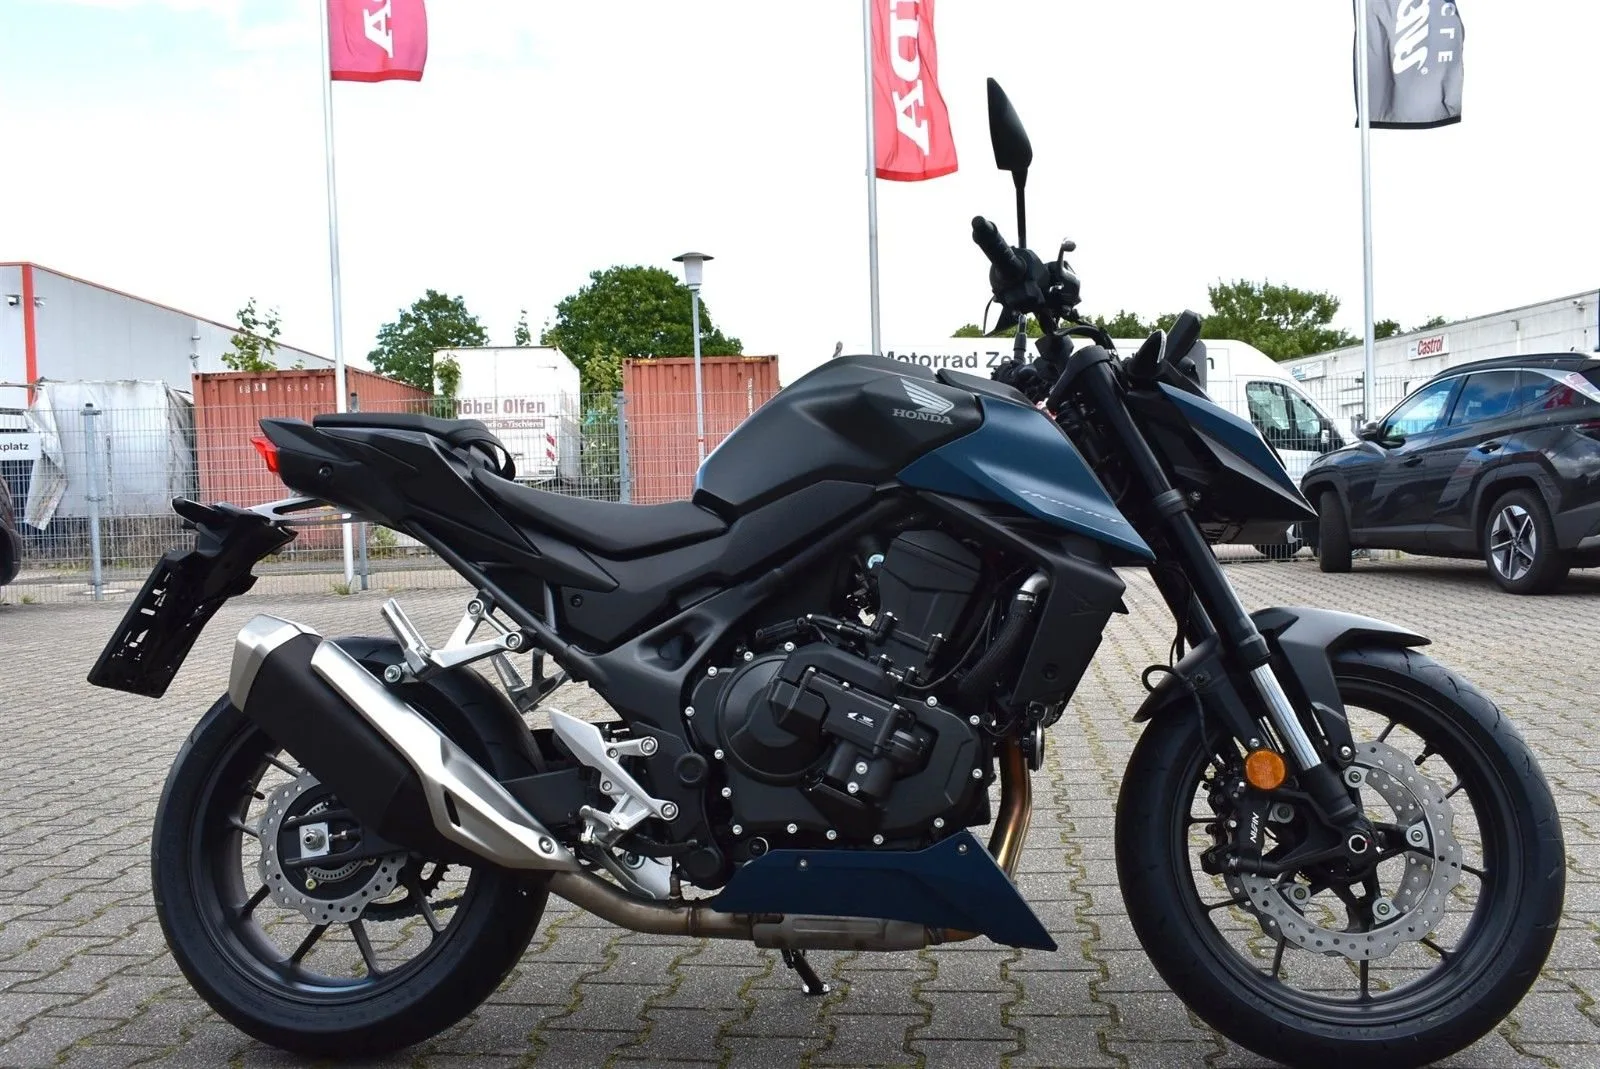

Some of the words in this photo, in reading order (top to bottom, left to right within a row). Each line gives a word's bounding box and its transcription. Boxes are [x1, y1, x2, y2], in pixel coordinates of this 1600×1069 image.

[1417, 335, 1444, 355] Castrol
[503, 398, 546, 414] Olfen
[892, 408, 954, 425] HONDA
